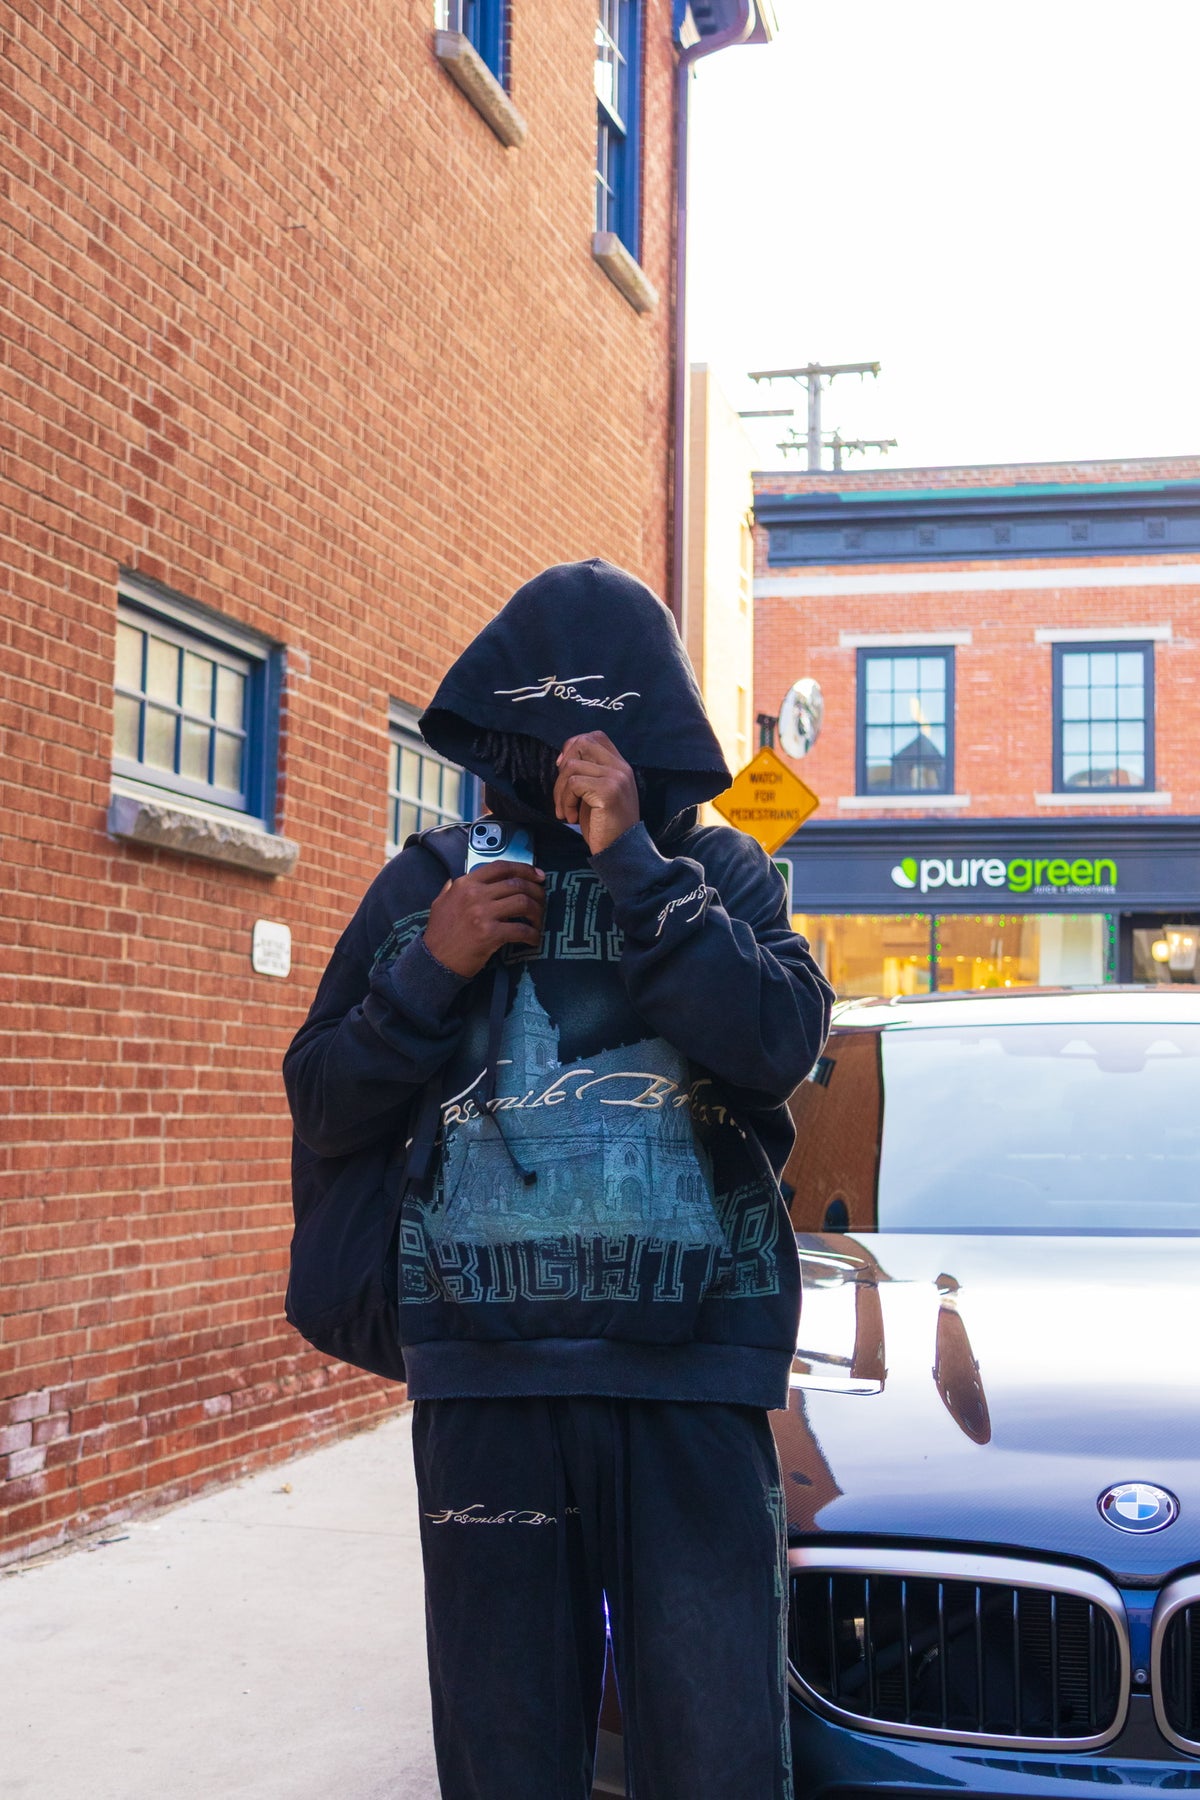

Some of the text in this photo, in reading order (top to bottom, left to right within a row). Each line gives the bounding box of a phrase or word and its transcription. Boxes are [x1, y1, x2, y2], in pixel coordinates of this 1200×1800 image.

[750, 772, 783, 785] WATCH
[754, 790, 776, 802] FOR
[730, 808, 799, 821] PEDESTRIANS
[1110, 1484, 1168, 1500] BMW
